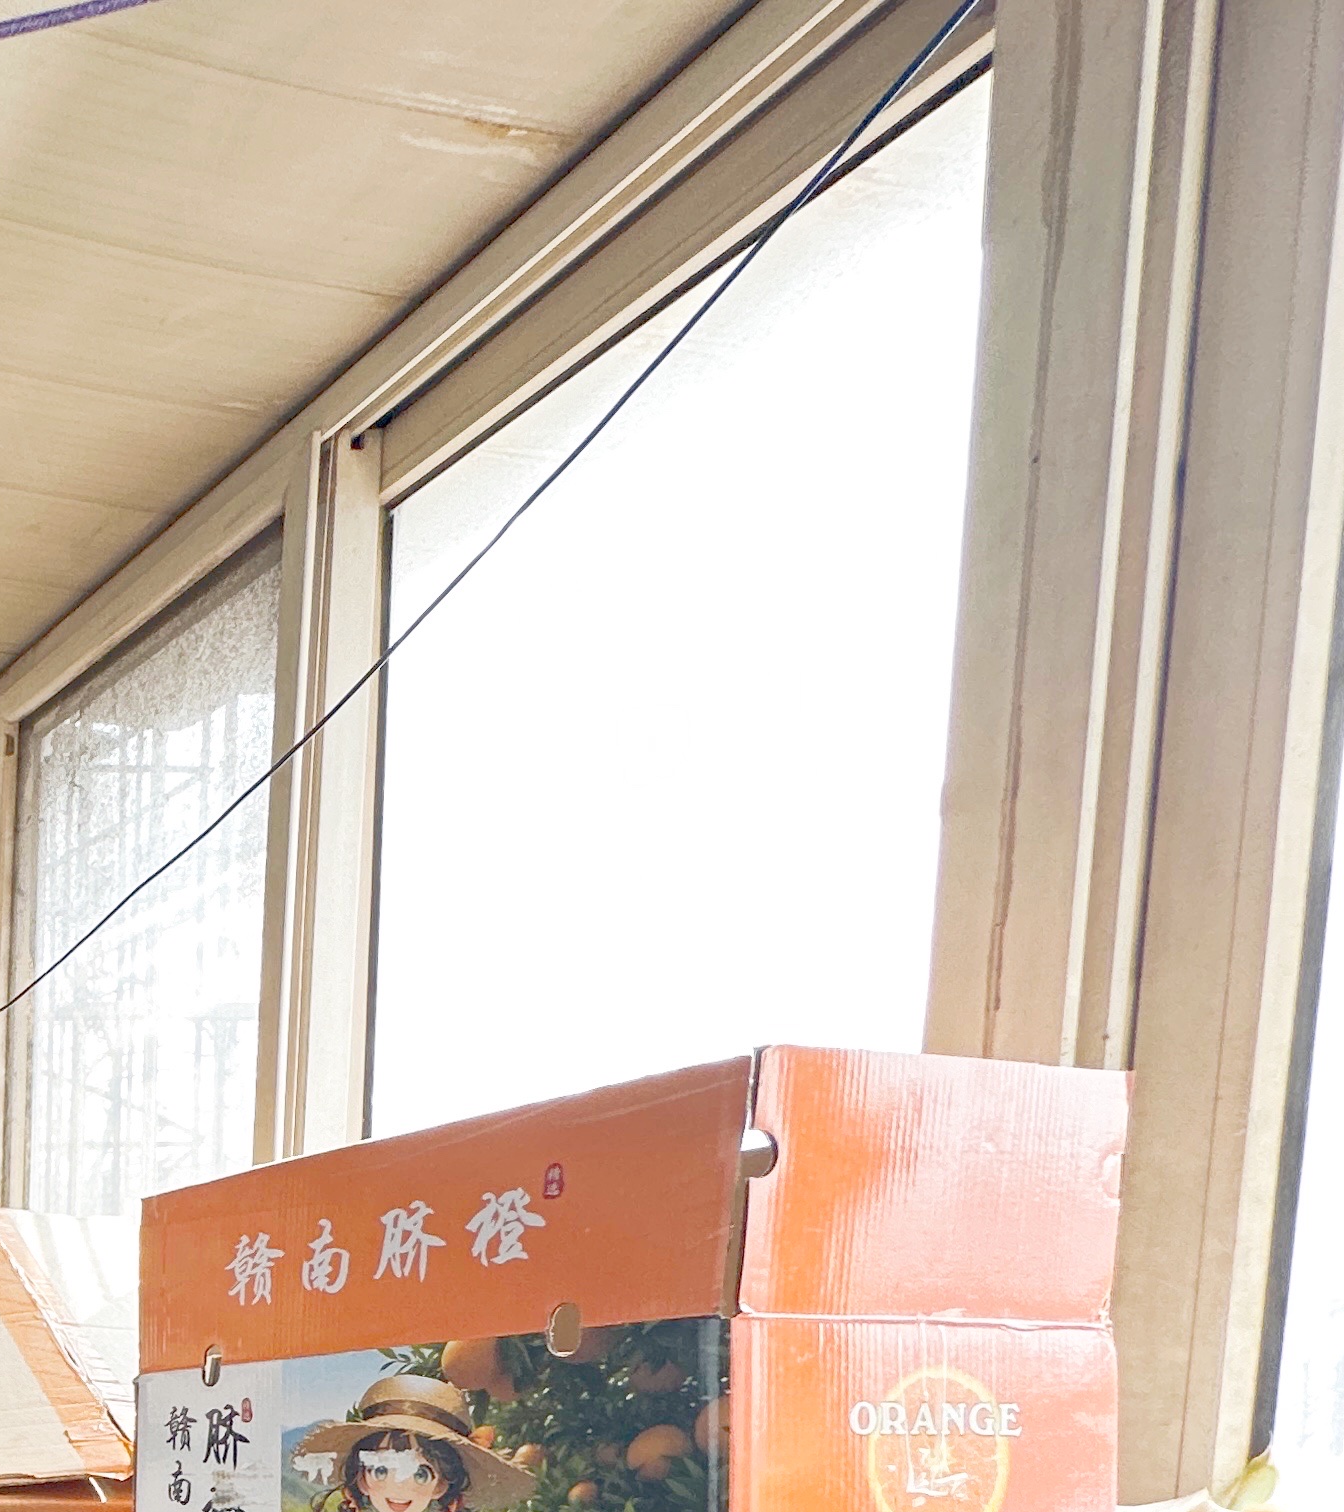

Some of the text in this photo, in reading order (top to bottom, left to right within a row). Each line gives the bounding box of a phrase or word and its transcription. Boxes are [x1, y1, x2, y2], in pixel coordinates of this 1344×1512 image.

[224, 1186, 547, 1306] 赣南脐橙
[849, 1401, 1023, 1437] ORANGE
